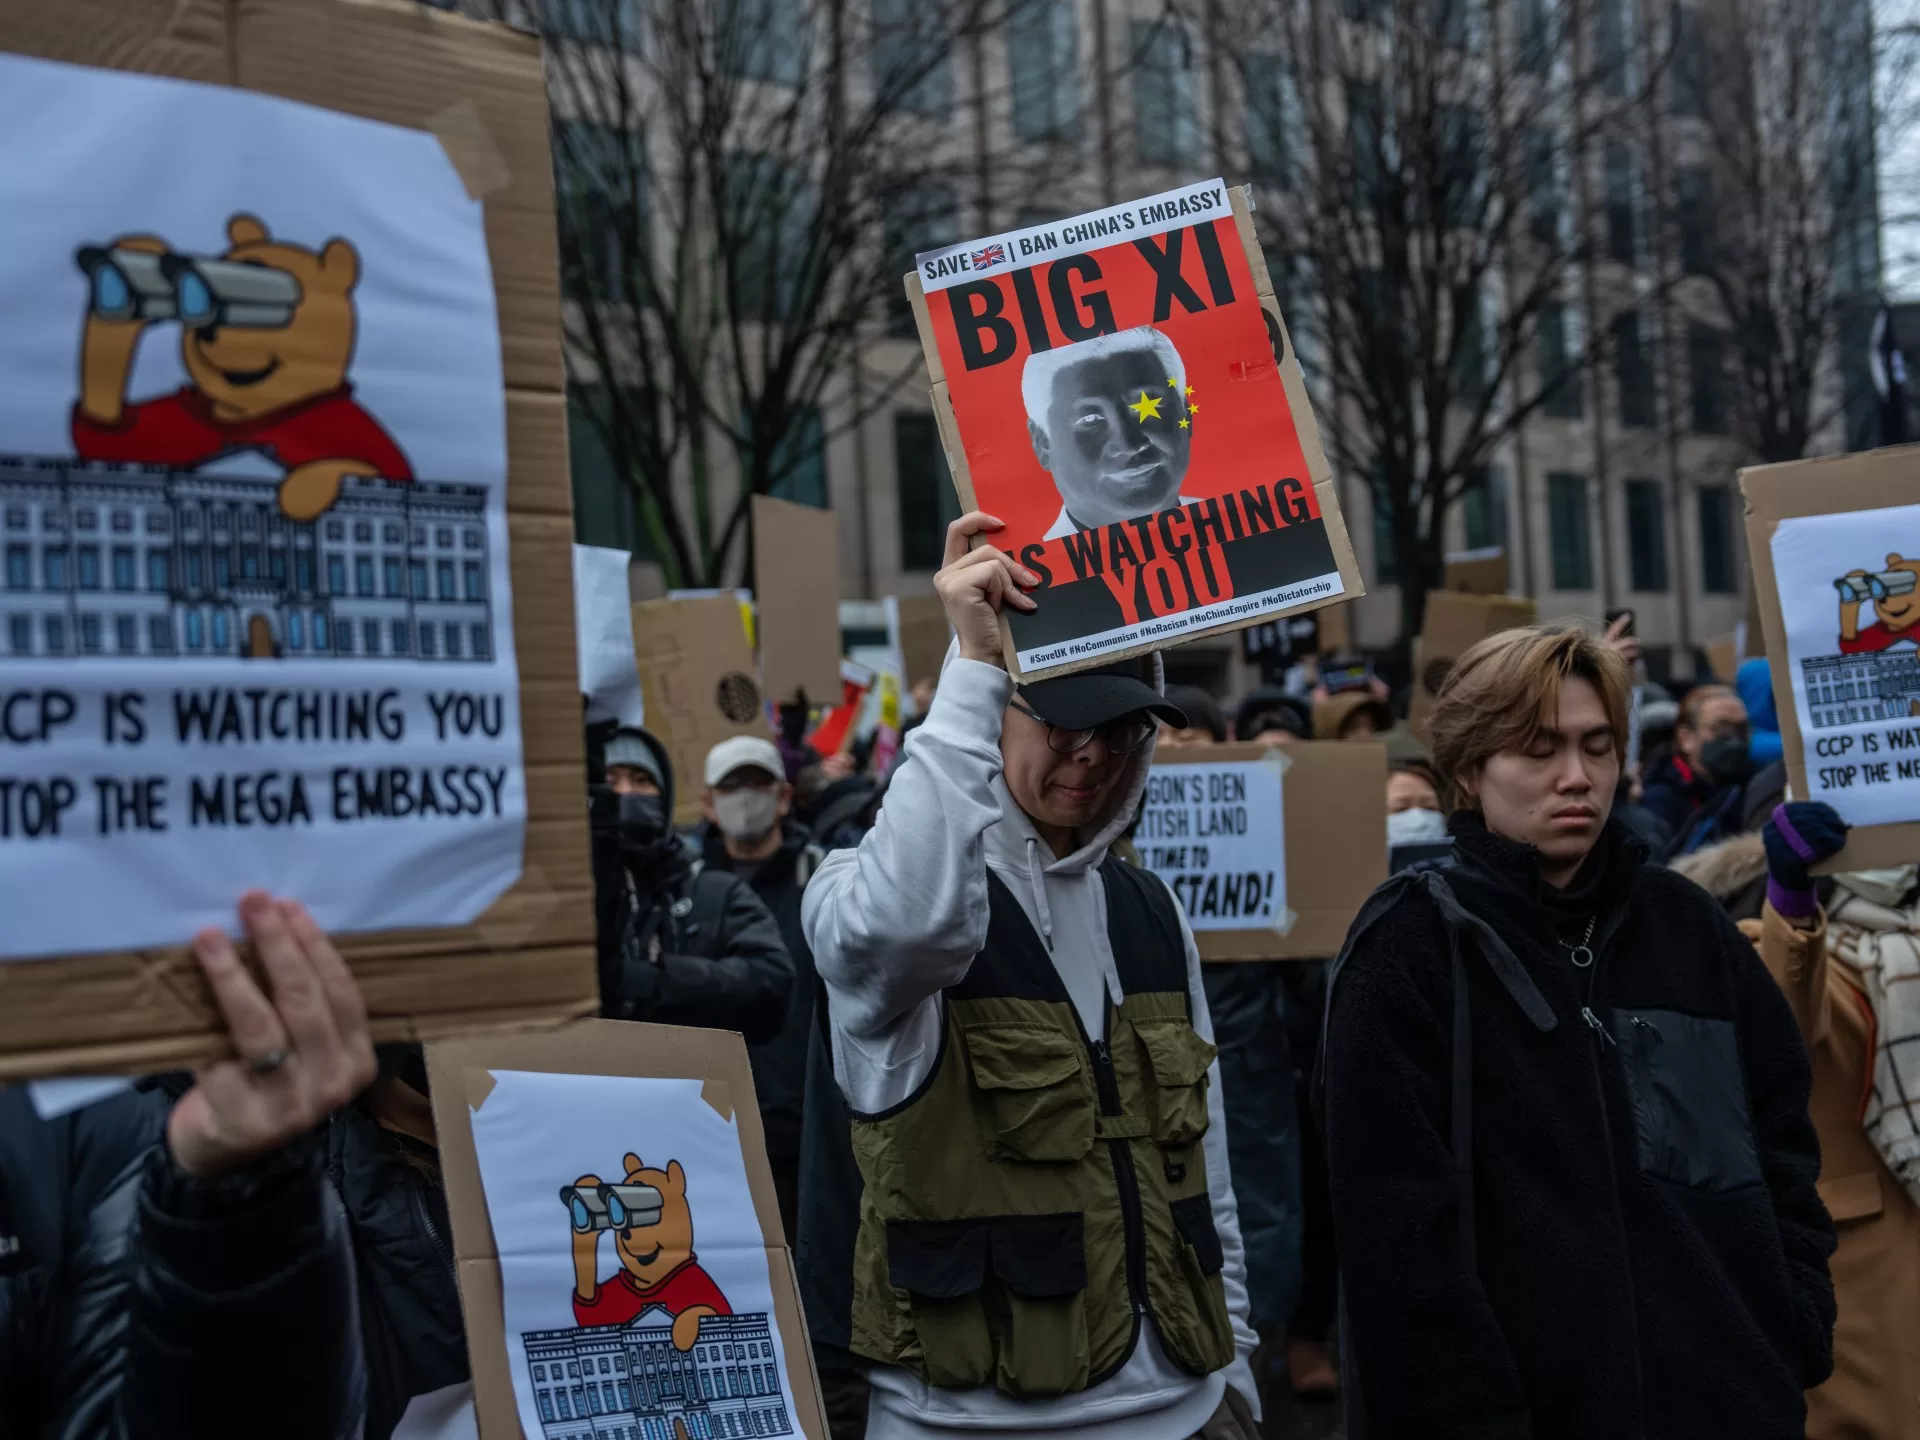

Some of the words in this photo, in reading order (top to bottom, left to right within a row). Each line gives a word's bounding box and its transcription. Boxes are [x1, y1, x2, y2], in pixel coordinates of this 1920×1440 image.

[924, 252, 971, 280] SAVE
[1020, 231, 1057, 256] BAN
[1062, 211, 1135, 245] CHINA'S
[1138, 188, 1222, 226] EMBASSY
[946, 253, 1118, 372] BIG
[1132, 220, 1236, 324] XI
[1002, 543, 1053, 590] S
[1060, 477, 1311, 581] WATCHING
[1100, 543, 1235, 626] YOU
[1030, 647, 1068, 664] #SaveUK
[1069, 631, 1138, 656] #NoCommunism
[1139, 617, 1188, 638] #NoRacism
[1189, 601, 1260, 624] #NoChinaEmpire
[1261, 581, 1332, 607] #NoDictatorship
[0, 687, 77, 745] CP
[103, 690, 147, 745] IS
[173, 686, 404, 743] WATCHING
[428, 690, 503, 741] YOU
[1816, 735, 1854, 757] CCP
[1862, 732, 1879, 753] IS
[92, 776, 168, 836] THE
[189, 771, 312, 829] MEGA
[332, 765, 507, 821] EMBASSY
[1209, 772, 1246, 803] DEN
[1819, 765, 1857, 789] STOP
[1861, 762, 1891, 785] THE
[1196, 806, 1248, 837] LAND
[1152, 845, 1187, 869] TIME
[1192, 844, 1210, 869] TO
[1173, 870, 1274, 918] STAND!
